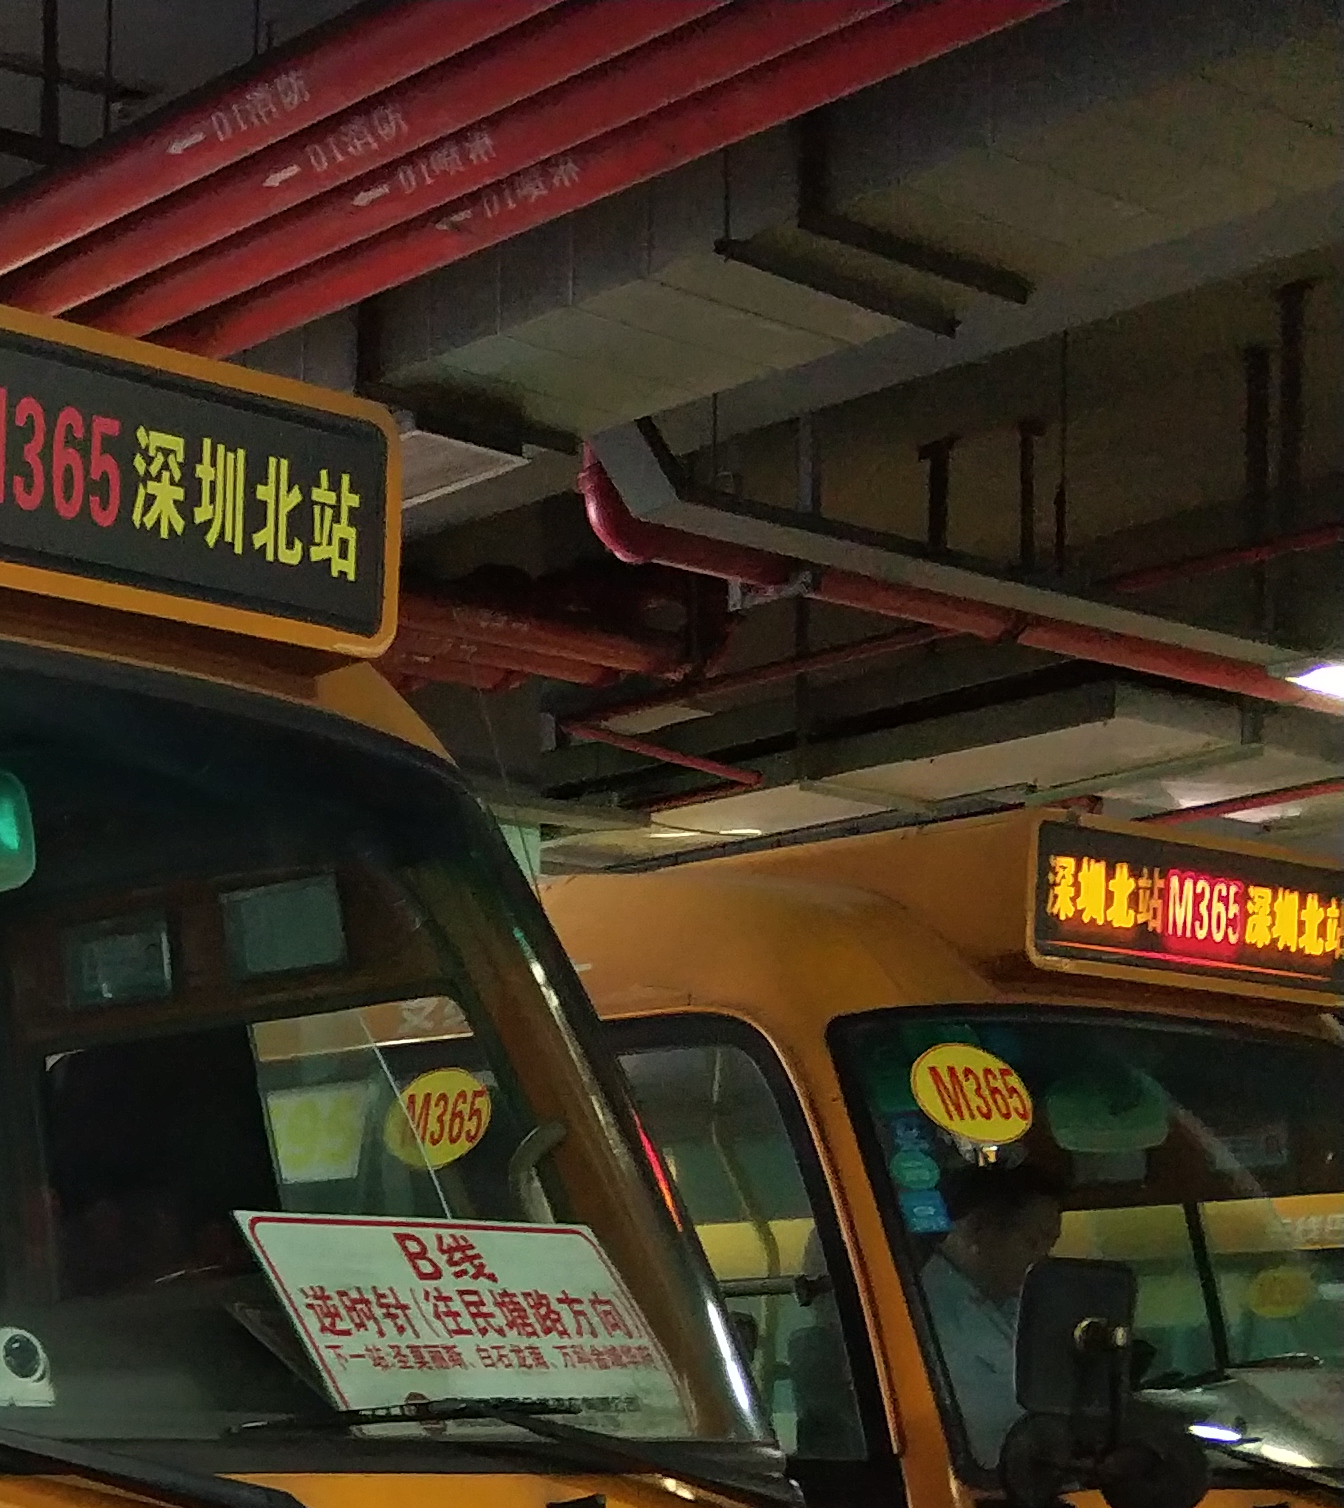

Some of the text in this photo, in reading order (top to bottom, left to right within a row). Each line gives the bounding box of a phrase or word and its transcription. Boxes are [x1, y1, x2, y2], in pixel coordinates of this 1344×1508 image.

[131, 425, 361, 581] 深圳北站
[1047, 855, 1165, 933] 深圳北站
[1167, 873, 1243, 945] M365
[401, 1086, 487, 1148] M365
[927, 1065, 1030, 1122] M365
[393, 1232, 498, 1283] B线
